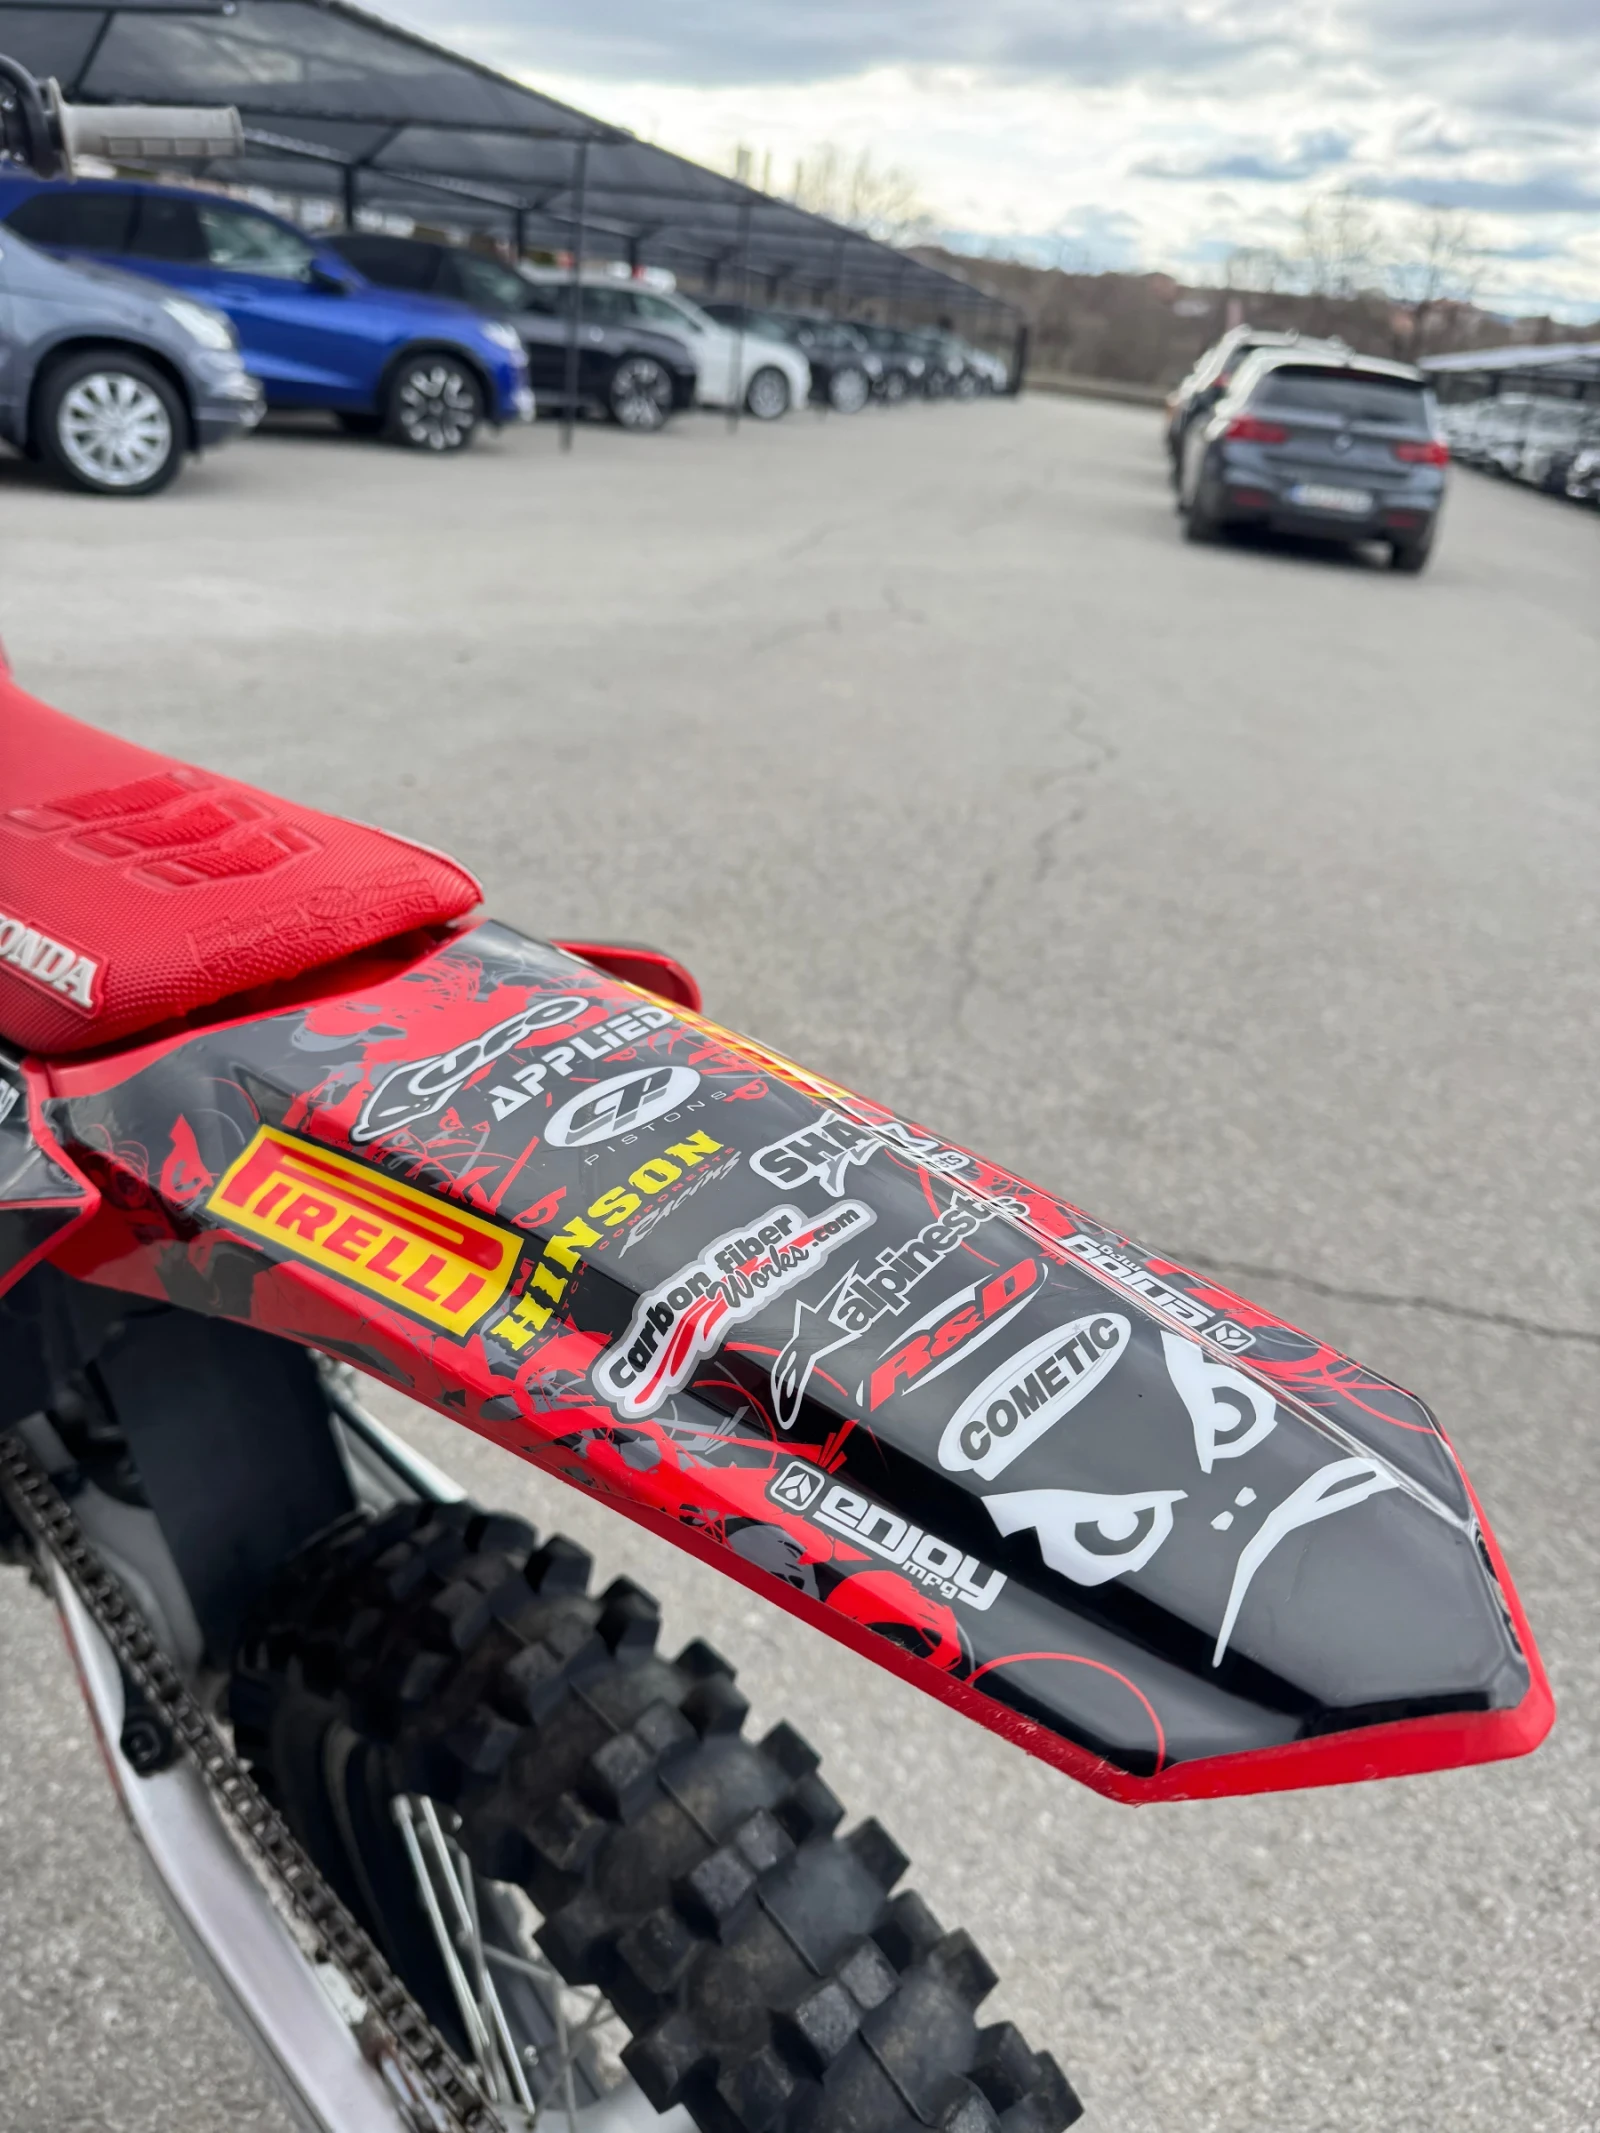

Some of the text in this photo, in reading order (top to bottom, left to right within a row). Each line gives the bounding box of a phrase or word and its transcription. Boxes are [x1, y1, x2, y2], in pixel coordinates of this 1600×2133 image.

[0, 913, 98, 1009] ONDA
[411, 998, 587, 1095] UFO
[584, 1090, 727, 1167] PISTONS
[220, 1137, 504, 1315] PIRELLI
[490, 1129, 724, 1352] HINSON
[523, 1147, 736, 1356] CLUTCH COMPONENTS
[714, 1214, 793, 1274] fiber
[834, 1190, 1031, 1334] alpinests
[870, 1258, 1038, 1412] R&D
[960, 1317, 1120, 1461] COMETIC
[812, 1485, 1008, 1611] enjoy
[902, 1559, 962, 1600] mfg
